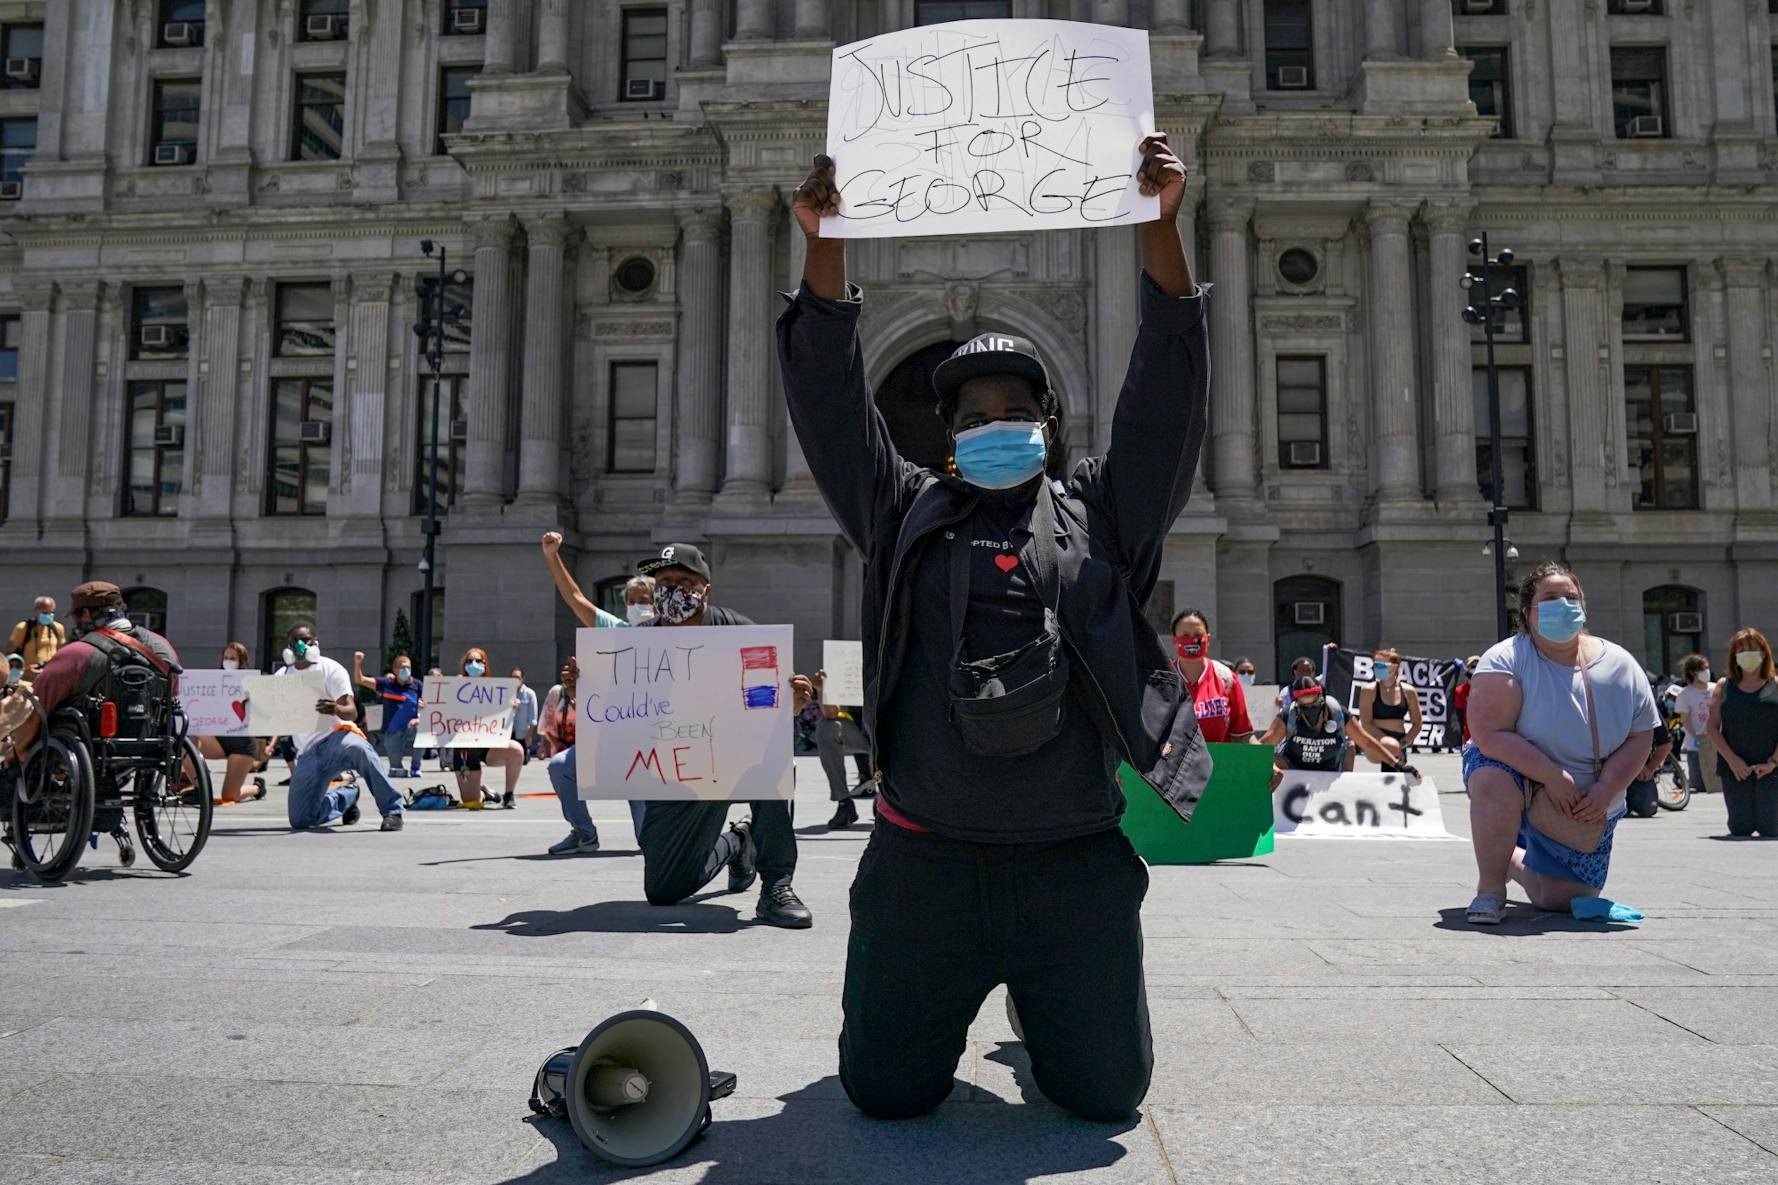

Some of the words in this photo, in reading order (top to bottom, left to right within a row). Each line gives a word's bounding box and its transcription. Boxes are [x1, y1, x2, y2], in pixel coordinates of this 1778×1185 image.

[838, 40, 1119, 142] JUSTICE
[914, 120, 1093, 166] FOR
[836, 168, 1132, 222] GEORGE
[971, 540, 1000, 549] PTED
[596, 644, 705, 685] THAT
[1353, 655, 1445, 687] BACK
[222, 674, 242, 697] FOR
[427, 682, 451, 705] I
[586, 691, 674, 723] Could've
[429, 710, 506, 737] Breathe!
[650, 716, 716, 740] BEEN
[625, 738, 718, 785] ME!
[1302, 744, 1325, 752] SAVE
